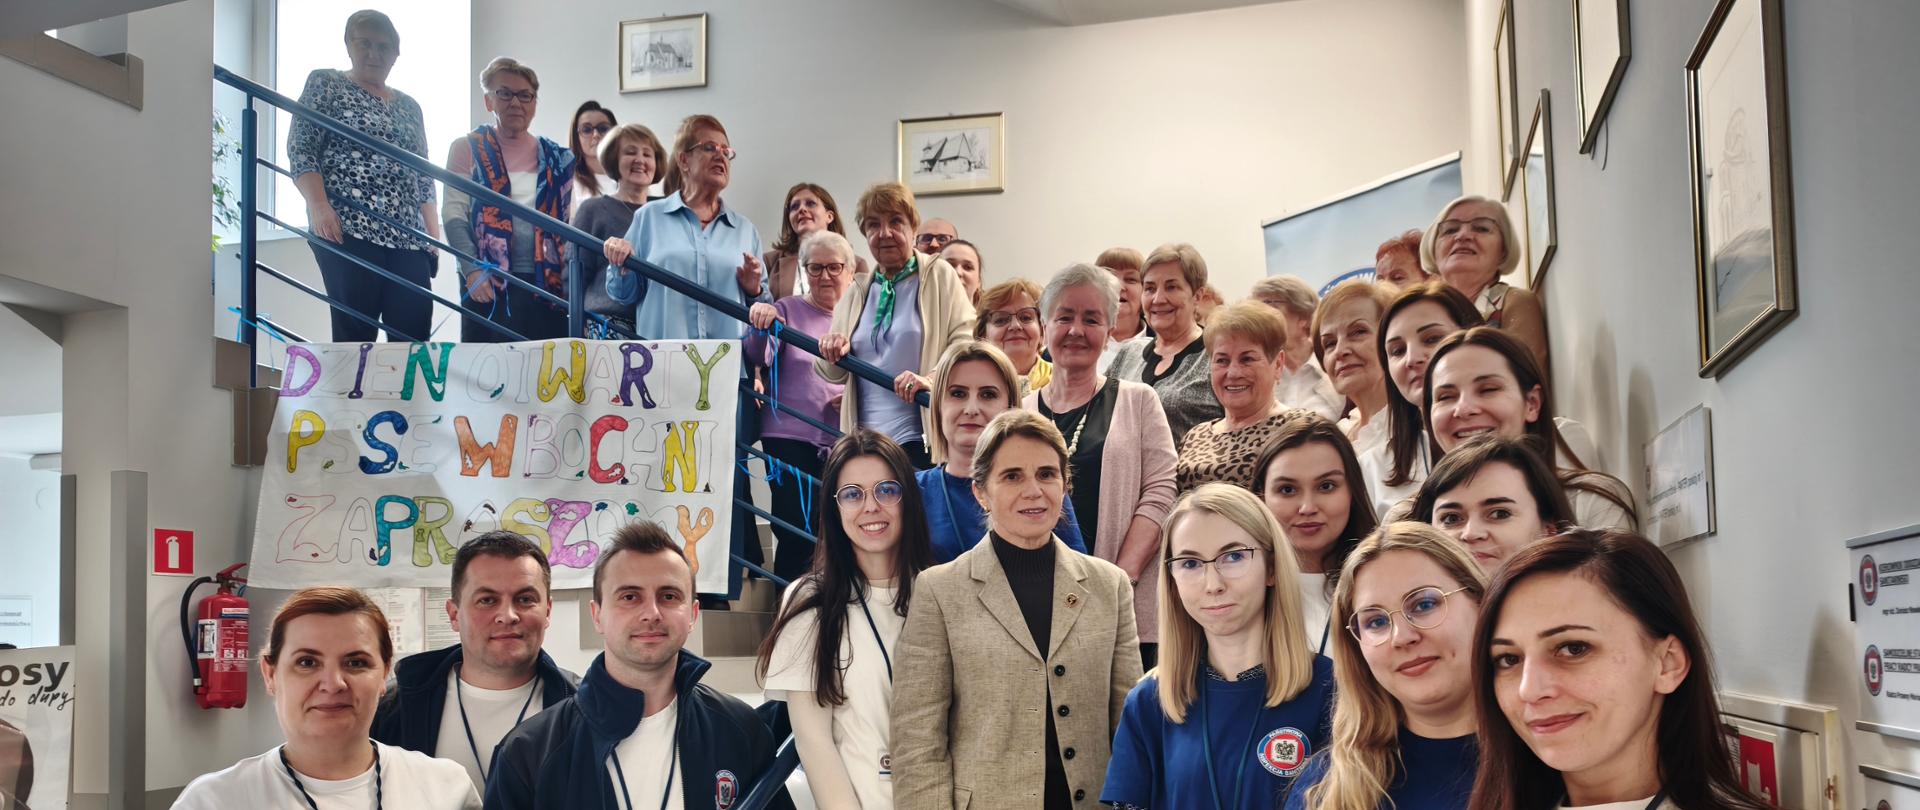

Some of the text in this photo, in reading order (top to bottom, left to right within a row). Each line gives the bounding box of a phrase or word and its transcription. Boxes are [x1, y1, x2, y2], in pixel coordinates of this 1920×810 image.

[466, 340, 731, 411] OTWARTY
[286, 409, 720, 494] PSSE W BOCHNI
[27, 685, 75, 711] dupy
